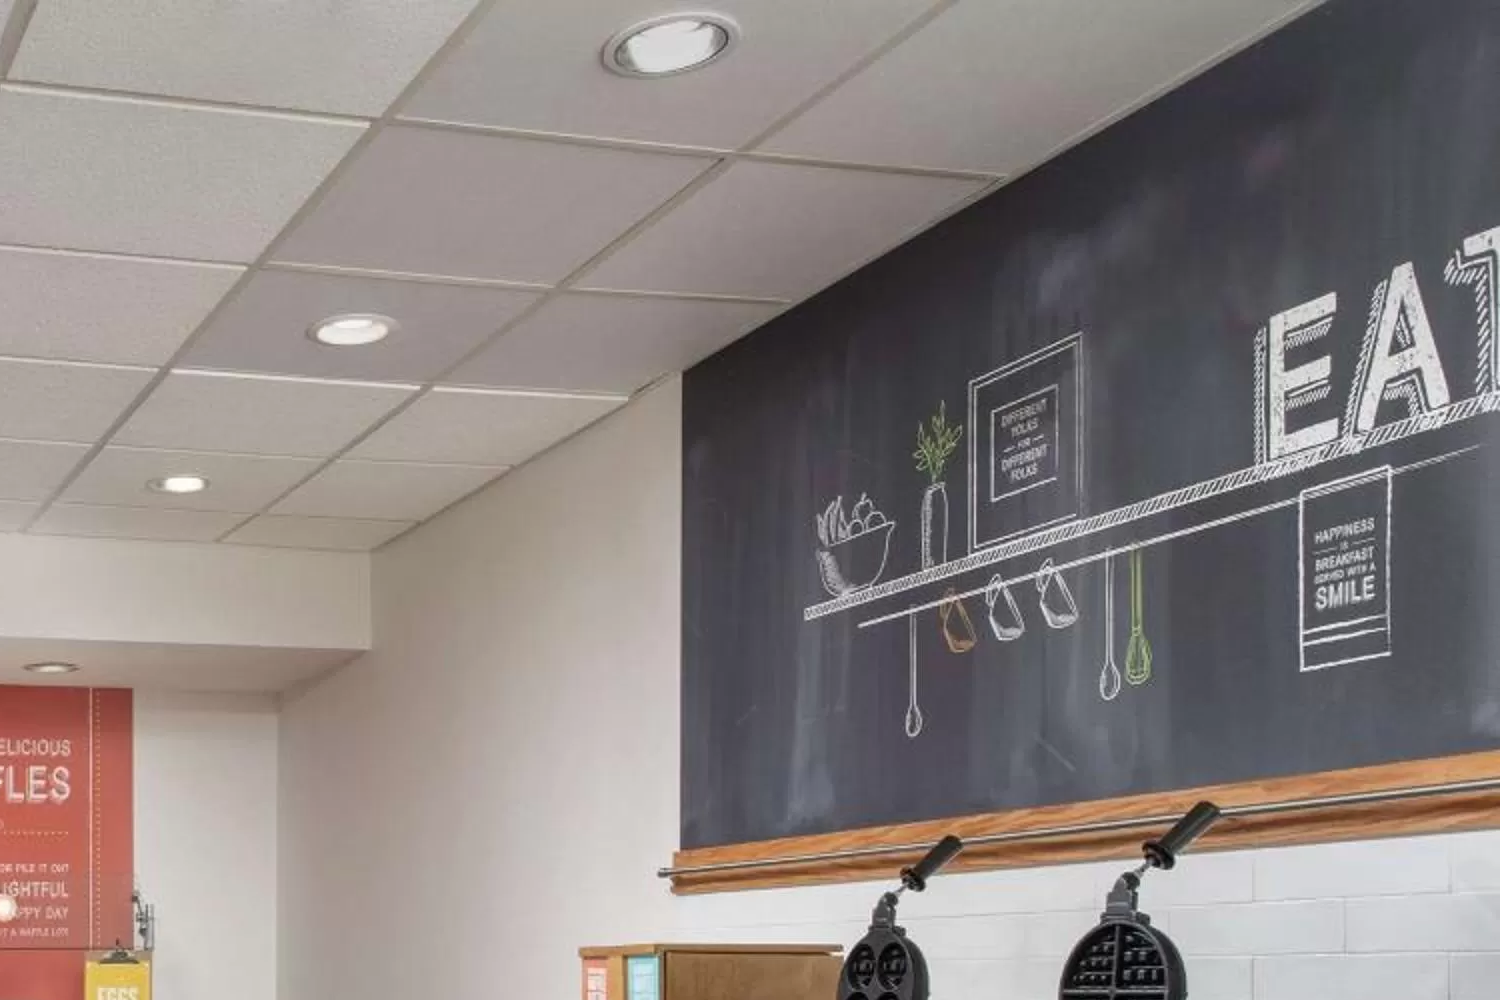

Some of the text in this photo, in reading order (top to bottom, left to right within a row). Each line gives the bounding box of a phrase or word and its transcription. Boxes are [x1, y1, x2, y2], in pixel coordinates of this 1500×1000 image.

[1001, 444, 1048, 472] DIFFERENT
[1315, 517, 1375, 544] HAPPINESS
[1315, 546, 1375, 572] BREAKFAST
[1315, 575, 1376, 610] SMILE
[46, 907, 69, 919] DAY
